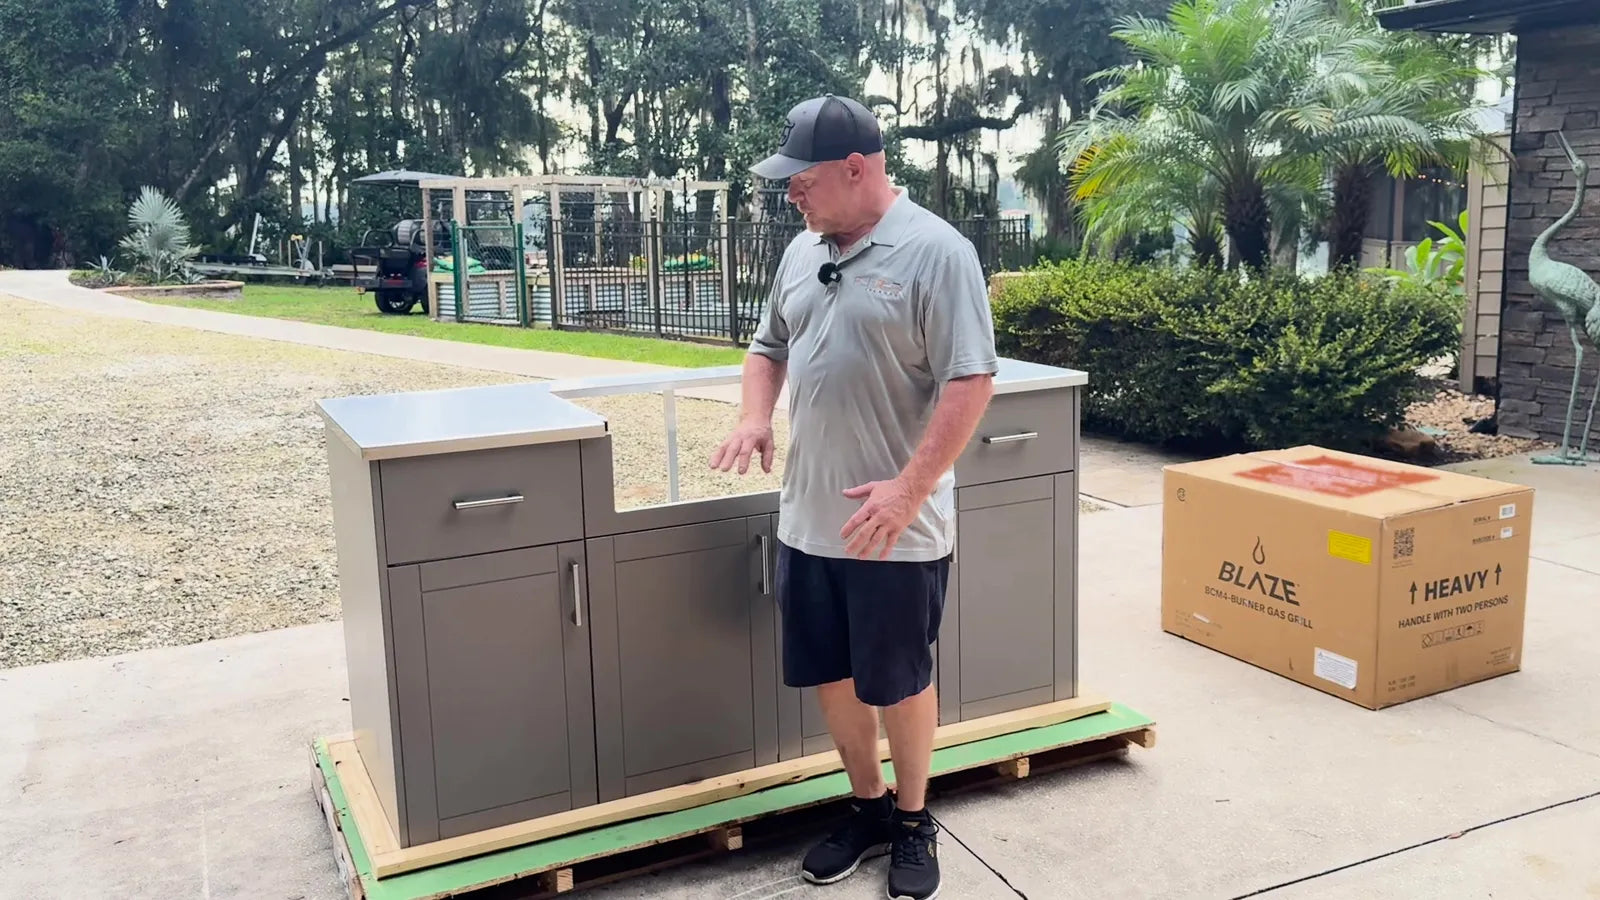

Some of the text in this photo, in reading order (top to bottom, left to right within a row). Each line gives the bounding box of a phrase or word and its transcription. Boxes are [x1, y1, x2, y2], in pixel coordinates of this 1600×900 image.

[1218, 561, 1300, 606] BLAZE
[1425, 569, 1488, 601] HEAVY
[1205, 585, 1265, 613] BCM4-BURNER
[1267, 606, 1286, 620] GAS
[1398, 595, 1509, 628] HANDLE WITH TWO PERSONS
